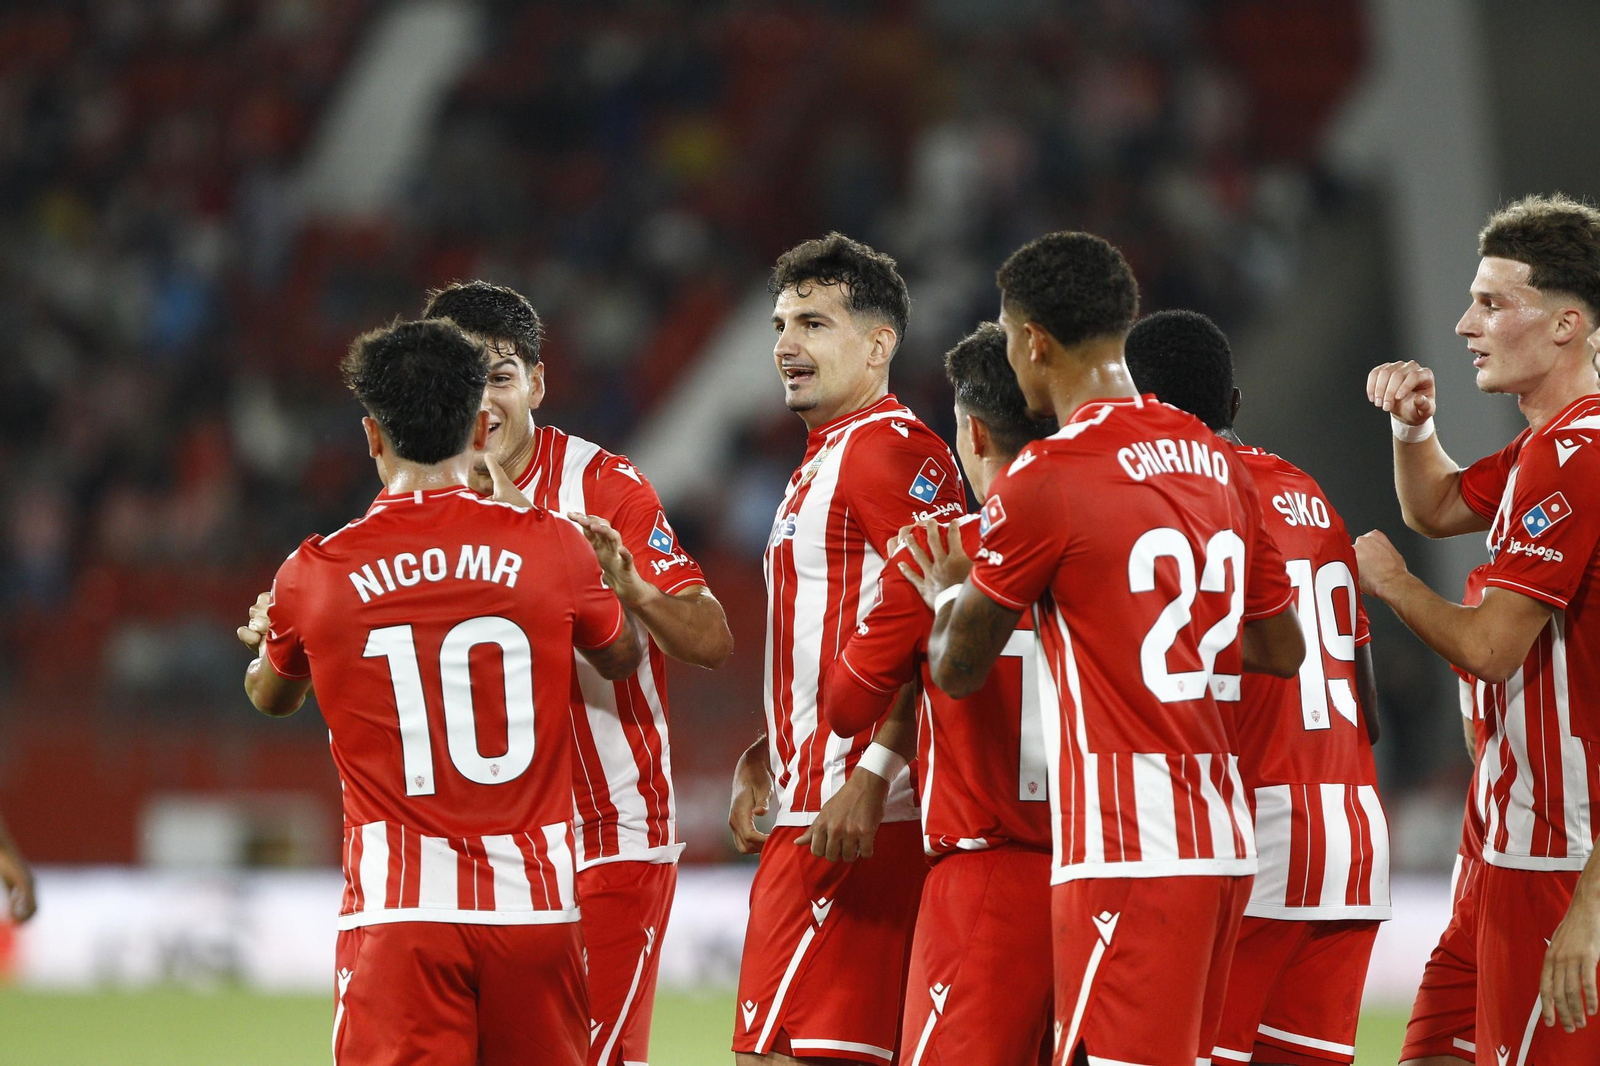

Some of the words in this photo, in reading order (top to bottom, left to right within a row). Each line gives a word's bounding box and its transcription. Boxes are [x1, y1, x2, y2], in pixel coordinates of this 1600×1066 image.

[1116, 438, 1229, 487] CHIRINO
[348, 547, 448, 604] NICO
[454, 544, 523, 589] MR
[1127, 527, 1246, 704] 22
[1286, 559, 1358, 731] 19
[362, 616, 536, 797] 10
